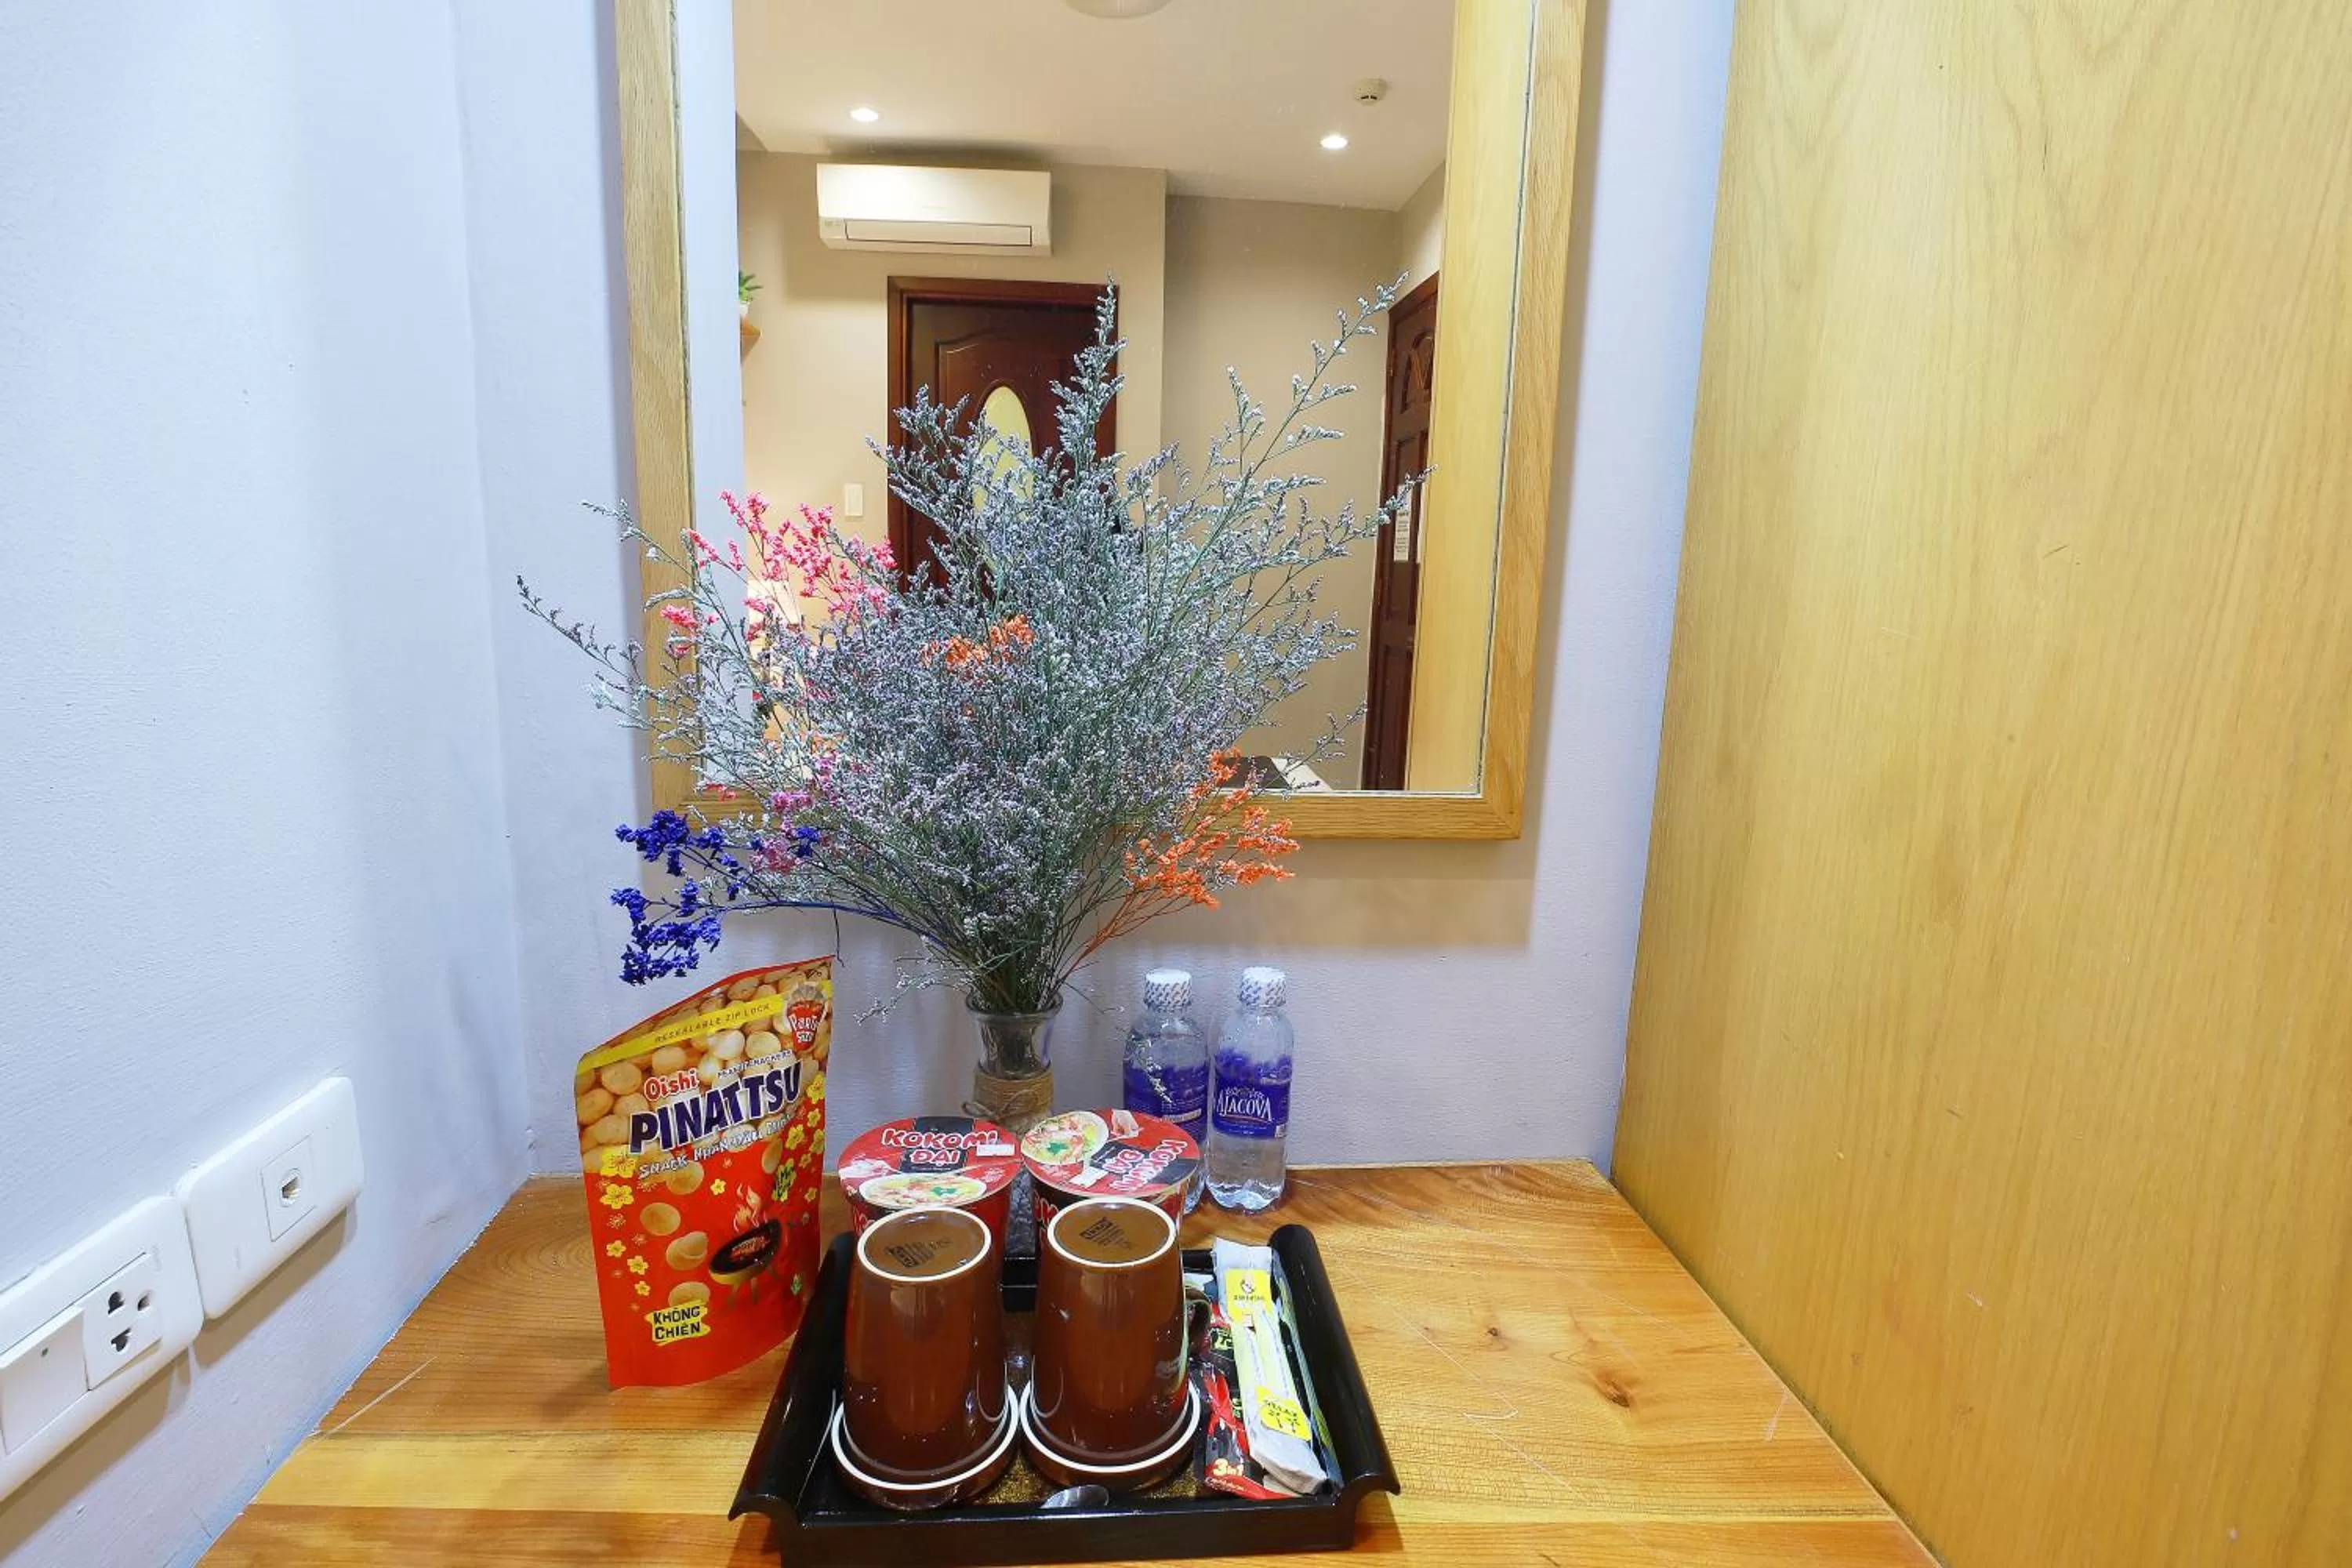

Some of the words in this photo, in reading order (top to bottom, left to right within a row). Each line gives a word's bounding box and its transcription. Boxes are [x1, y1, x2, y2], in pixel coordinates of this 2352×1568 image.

[644, 1068, 699, 1102] Oishi
[629, 1061, 804, 1155] PINATTSU
[880, 1128, 998, 1150] KOKOMI
